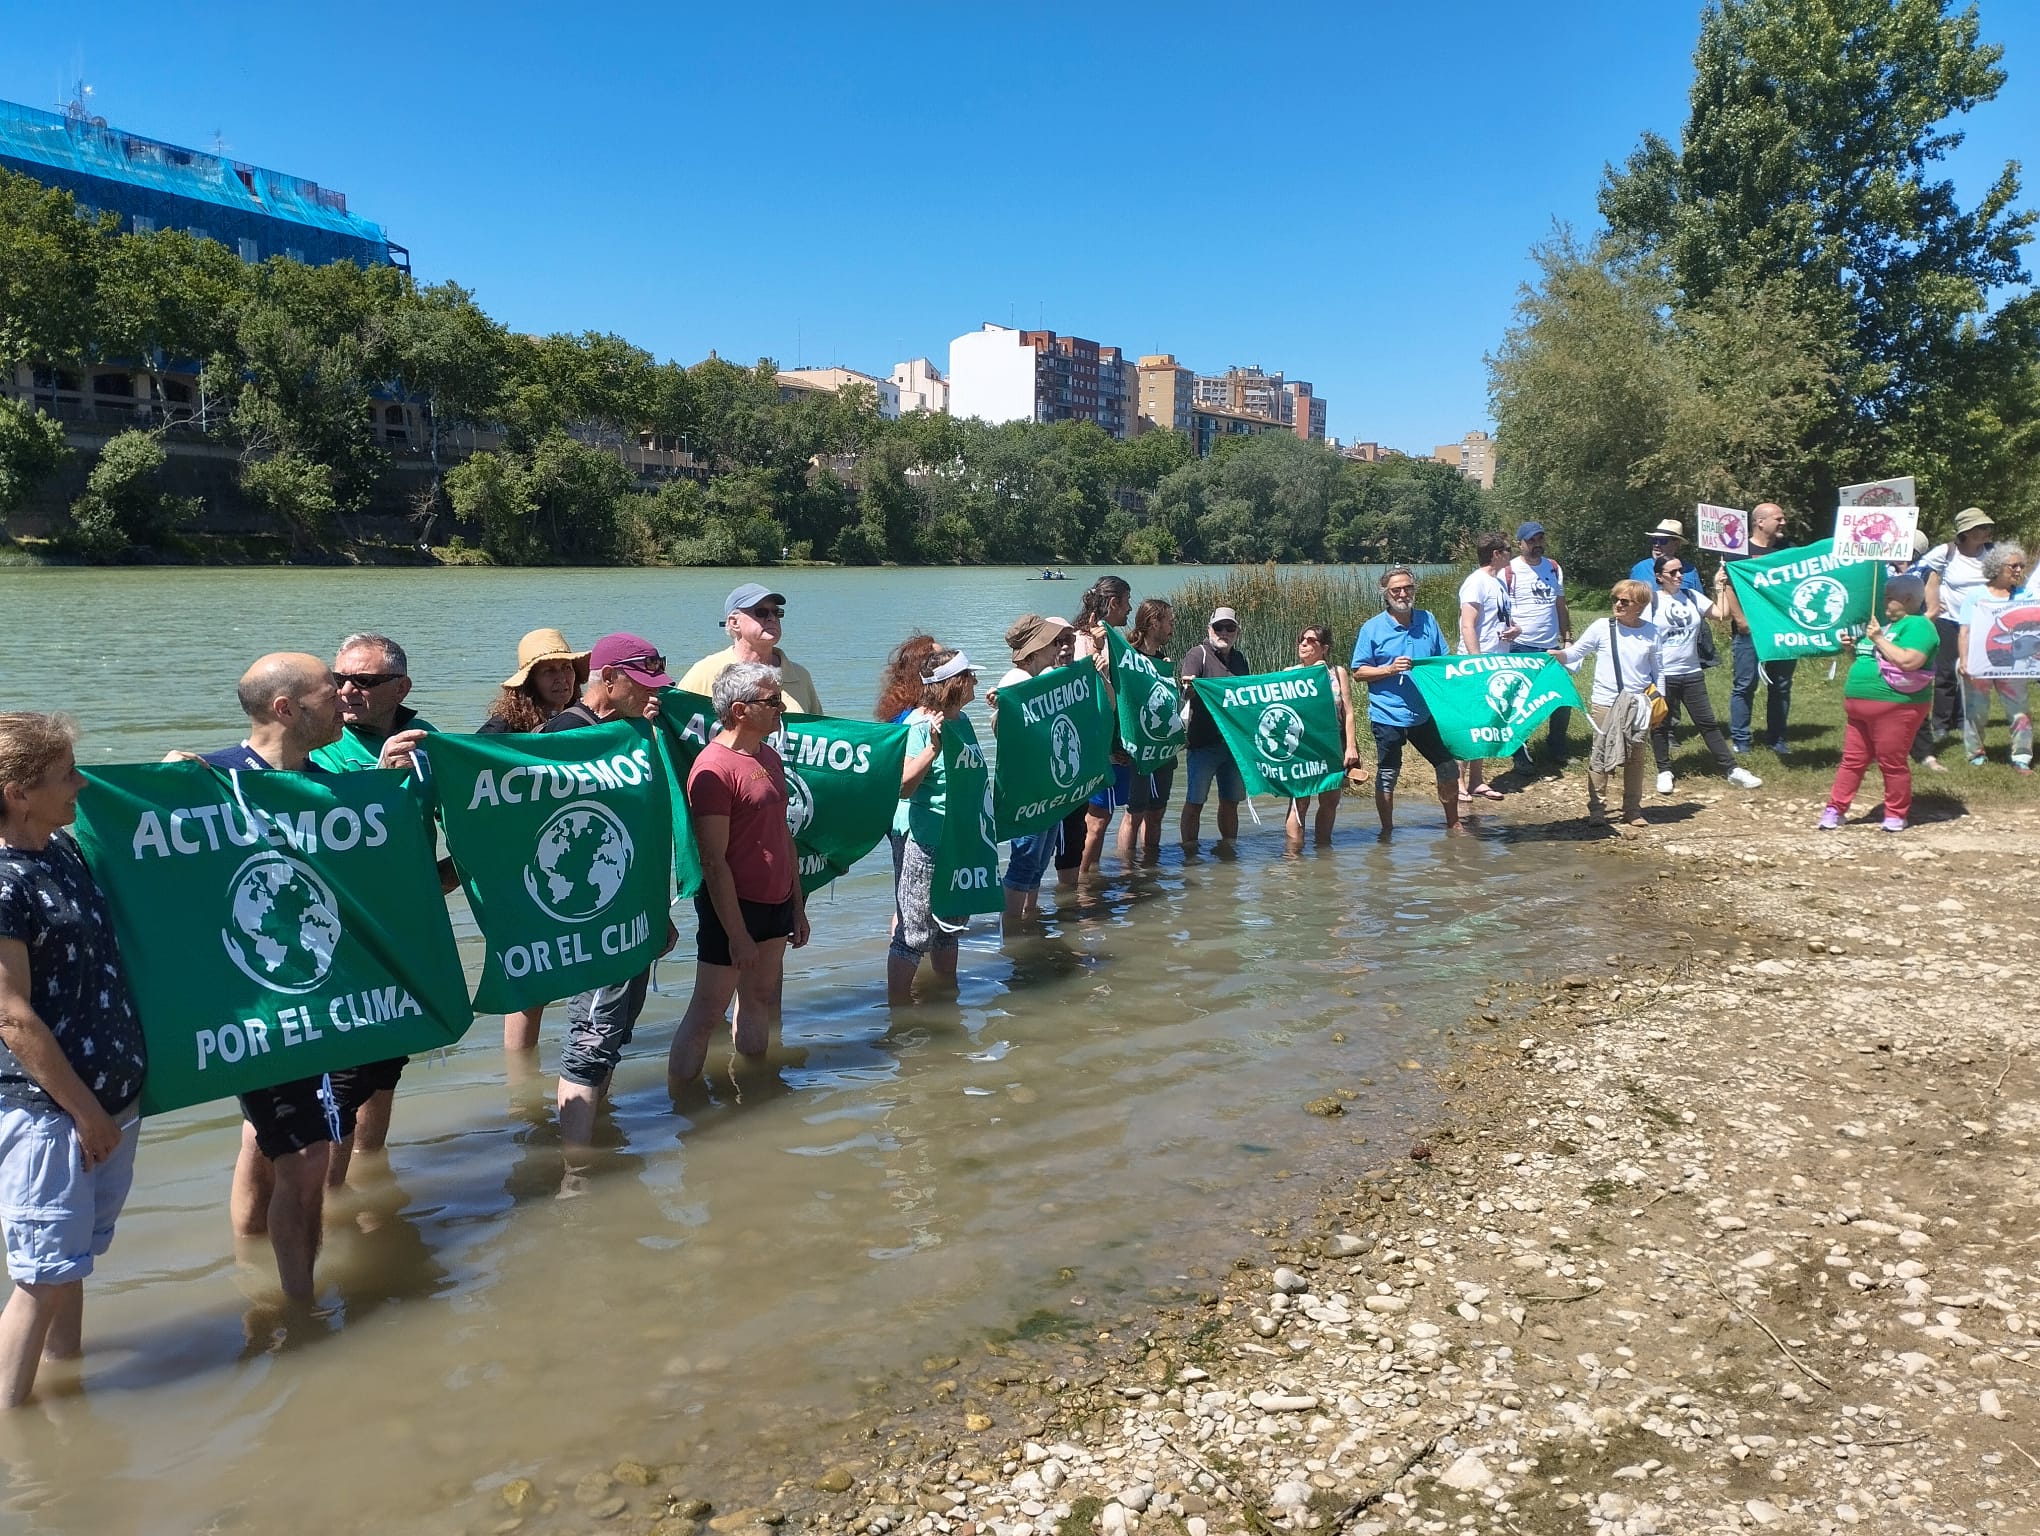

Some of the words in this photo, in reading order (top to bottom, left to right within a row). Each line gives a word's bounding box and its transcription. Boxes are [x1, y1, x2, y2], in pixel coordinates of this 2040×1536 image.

[1774, 632, 1809, 647] POR
[1445, 656, 1546, 680] ACTUEMOS
[1021, 675, 1090, 728] ACTUEMOS
[1222, 678, 1318, 708] ACTUEMOS
[1470, 727, 1501, 742] POR
[1142, 745, 1156, 760] EL
[467, 749, 653, 810] ACTUEMOS
[1291, 759, 1329, 780] CLIMA
[1015, 799, 1049, 822] POR
[1050, 794, 1068, 809] EL
[132, 802, 388, 860] ACTUEMOS
[496, 940, 553, 980] OR
[556, 933, 593, 967] EL
[195, 1018, 271, 1071] POR
[277, 1005, 323, 1047] EL
[329, 985, 423, 1033] CLIMA
